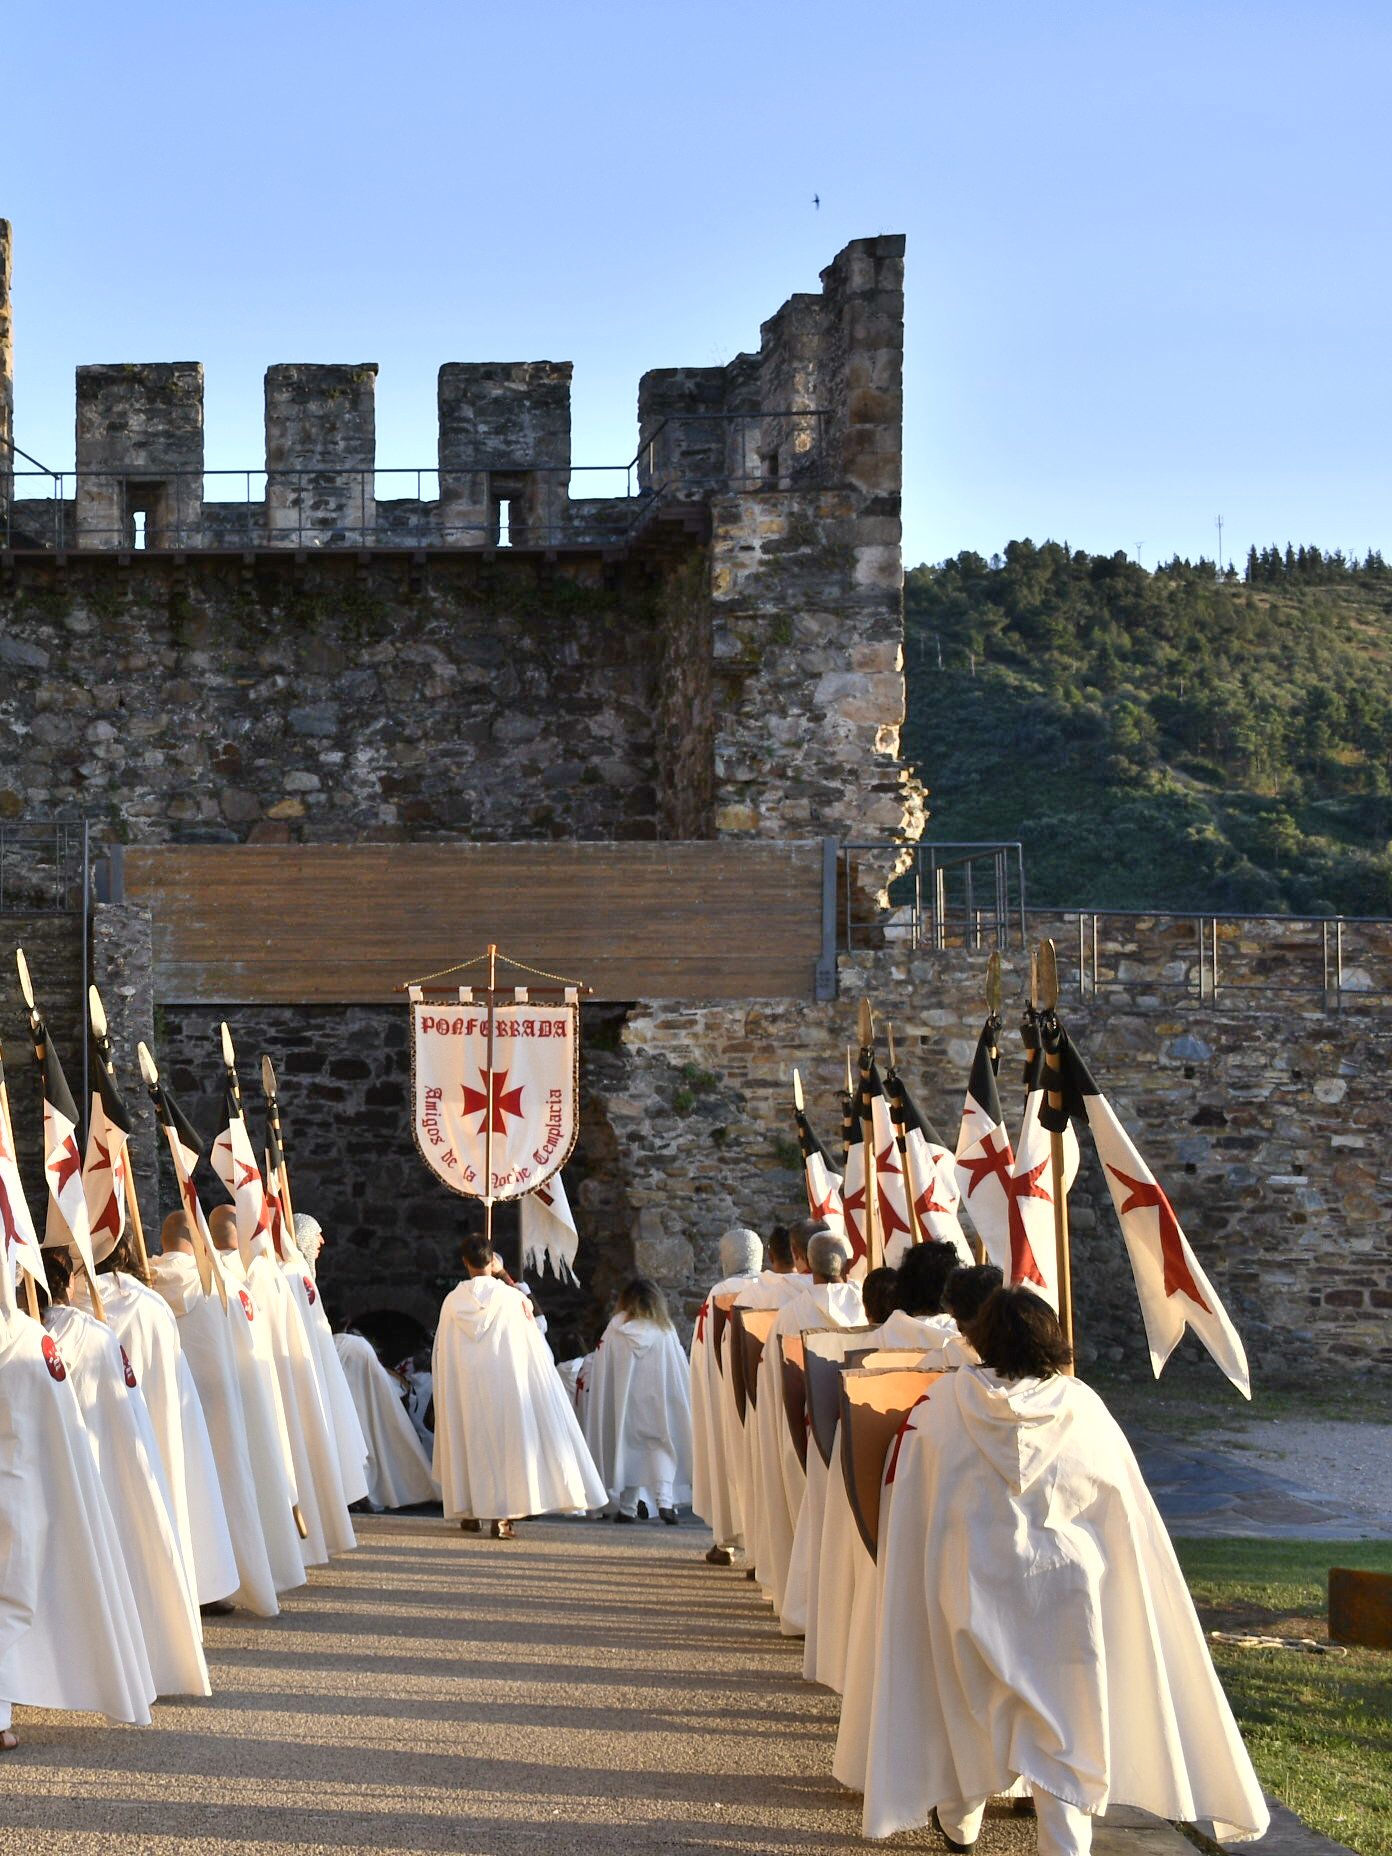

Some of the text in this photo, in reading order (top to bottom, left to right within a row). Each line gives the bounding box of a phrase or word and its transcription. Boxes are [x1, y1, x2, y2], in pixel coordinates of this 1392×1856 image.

[421, 1016, 567, 1038] PONFERRADA
[422, 1085, 445, 1146] Amigos
[441, 1148, 457, 1169] de
[463, 1165, 477, 1183] la
